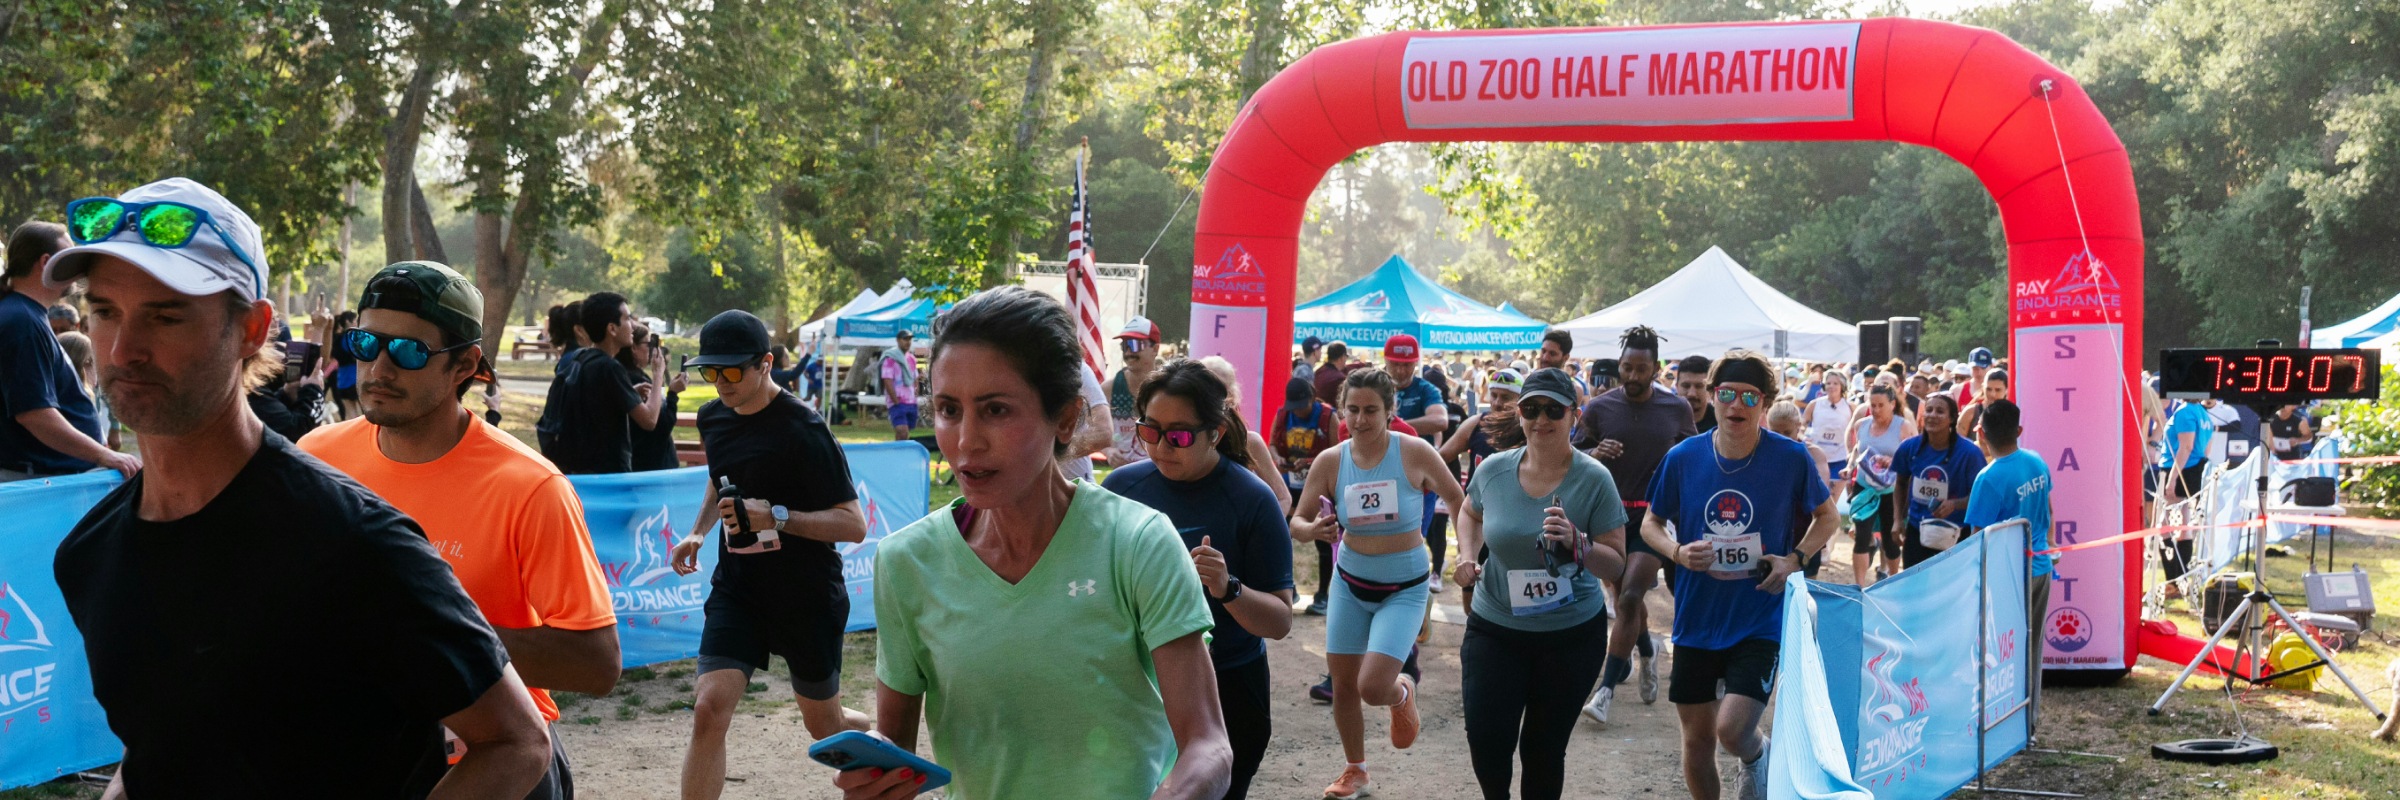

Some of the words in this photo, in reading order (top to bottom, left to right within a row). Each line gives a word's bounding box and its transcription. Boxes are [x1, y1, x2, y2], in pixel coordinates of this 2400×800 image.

[1407, 60, 1467, 102] OLD
[1477, 58, 1541, 100] ZOO
[1552, 54, 1640, 98] HALF
[1648, 47, 1848, 95] MARATHON
[1193, 265, 1212, 278] RAY
[2016, 278, 2051, 297] RAY
[2017, 294, 2121, 311] ENDURANCE
[2016, 310, 2122, 322] EVENTS
[2054, 334, 2080, 602] START
[1919, 486, 1940, 498] 438
[2016, 474, 2046, 502] STAFF
[1361, 492, 1380, 510] 23
[1715, 547, 1749, 565] 156
[1523, 581, 1558, 600] 419
[2055, 656, 2071, 664] HALF
[2073, 656, 2107, 664] MARATHON
